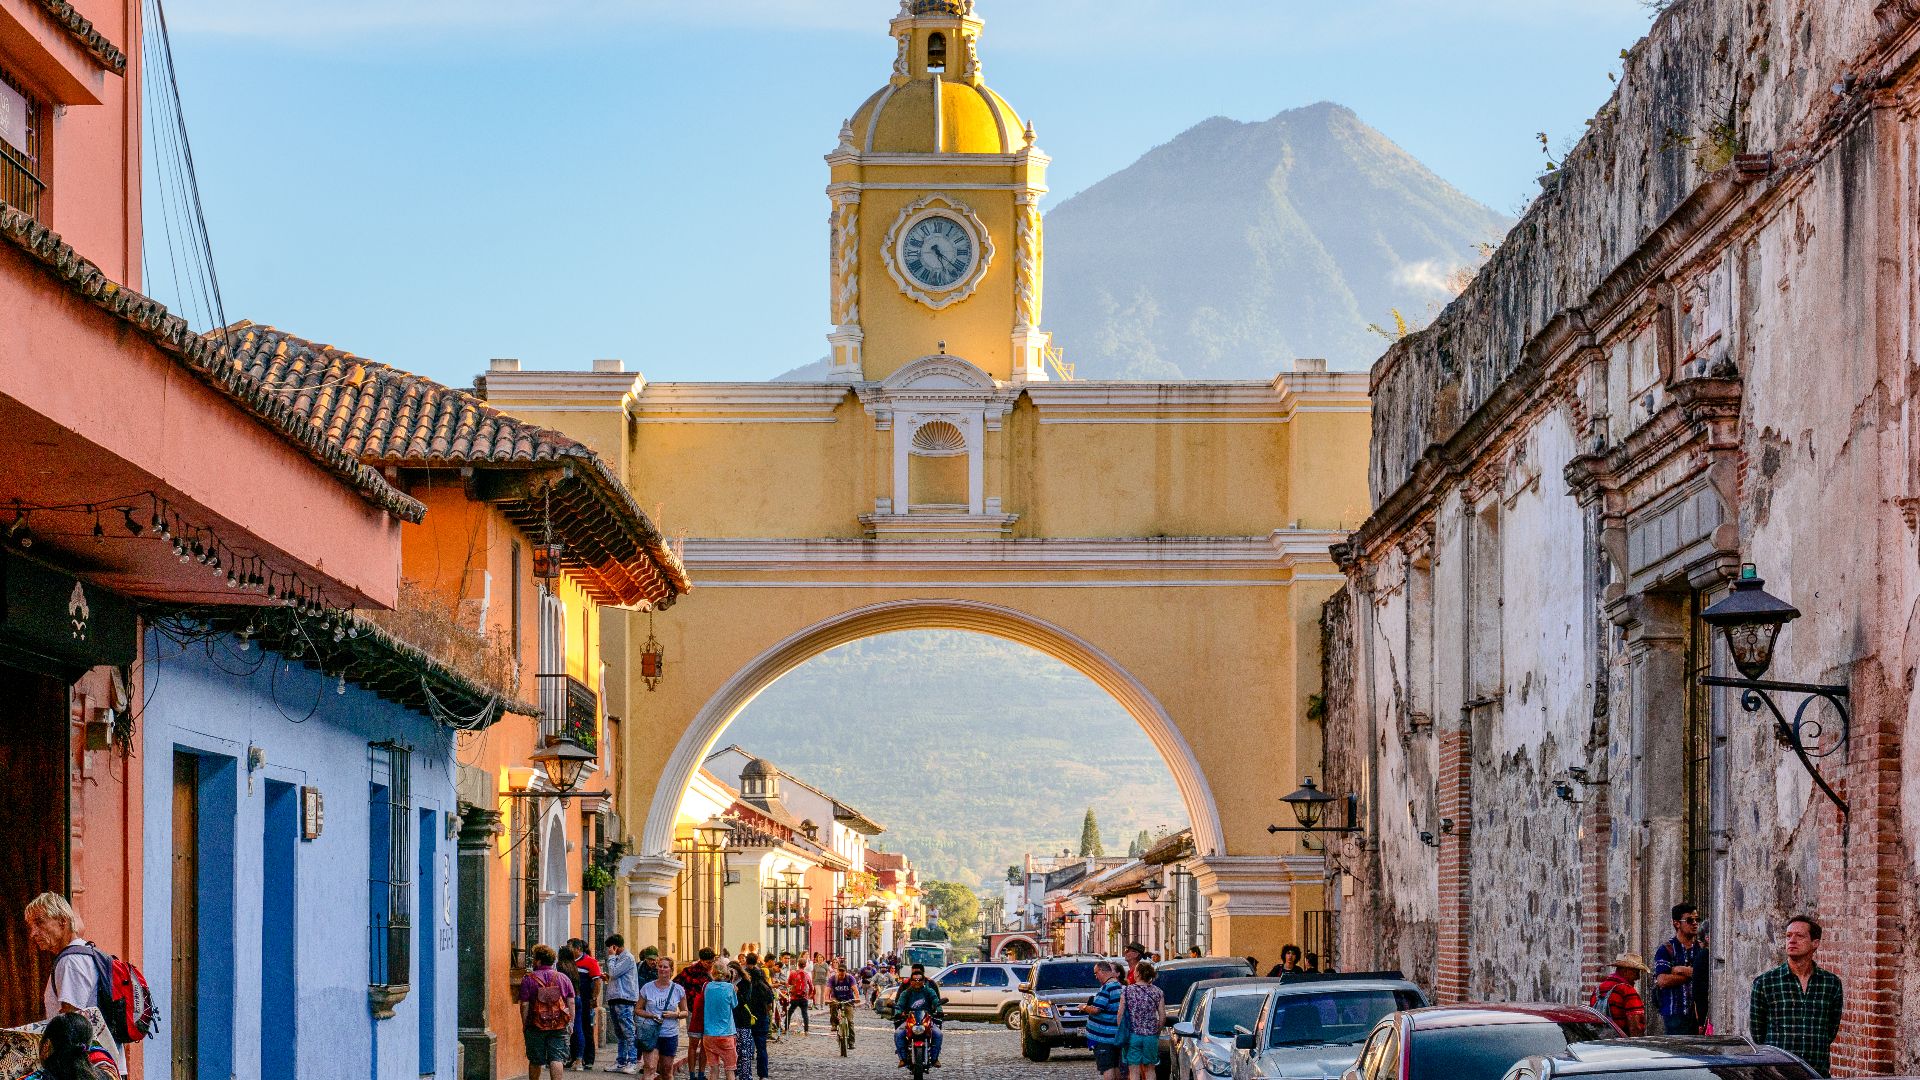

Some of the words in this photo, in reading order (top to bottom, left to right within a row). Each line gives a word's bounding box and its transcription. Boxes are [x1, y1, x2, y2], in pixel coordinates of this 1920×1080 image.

[933, 222, 943, 233] XII
[945, 226, 954, 237] I
[953, 236, 965, 245] II
